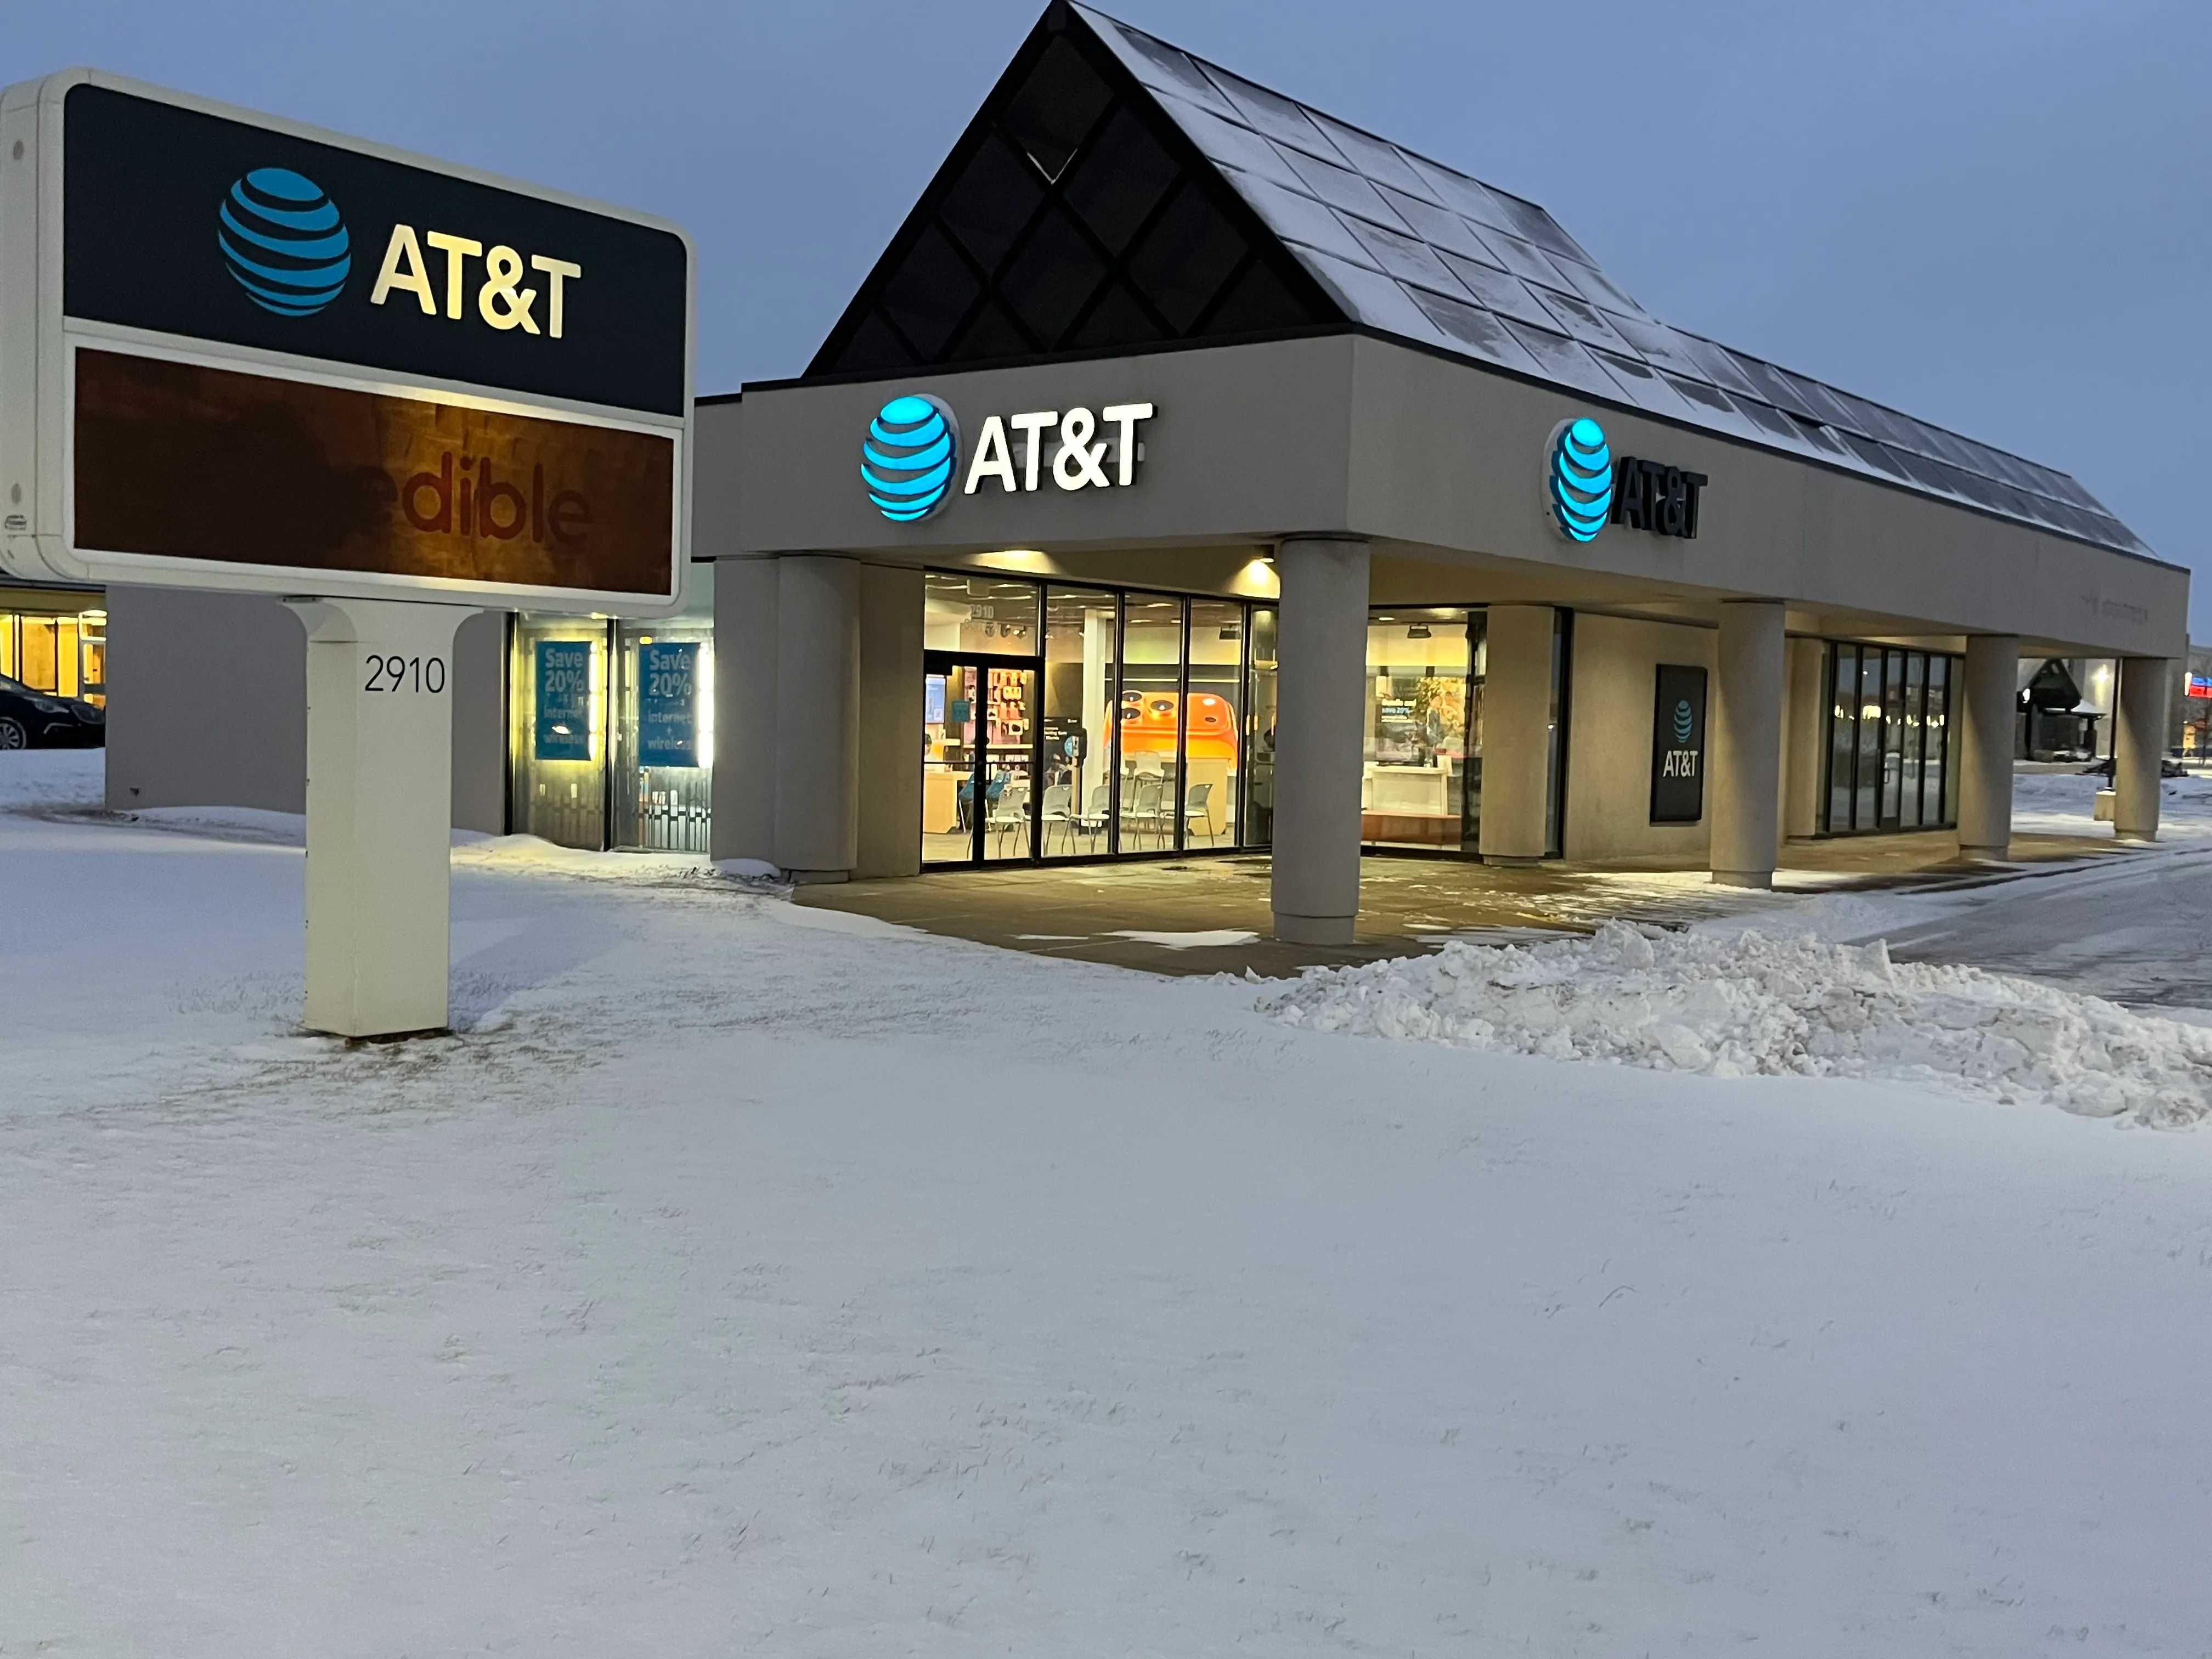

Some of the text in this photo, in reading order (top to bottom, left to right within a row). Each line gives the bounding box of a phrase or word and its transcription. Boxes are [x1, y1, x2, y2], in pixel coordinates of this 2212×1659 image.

[370, 223, 581, 338] AT&T
[964, 402, 1153, 494] AT&T
[1611, 456, 1708, 539] AT&T
[545, 647, 583, 668] Save
[649, 649, 691, 670] Save
[365, 654, 445, 693] 2910
[545, 669, 585, 692] 20%
[649, 672, 692, 696] 20%
[1662, 750, 1699, 777] AT&T
